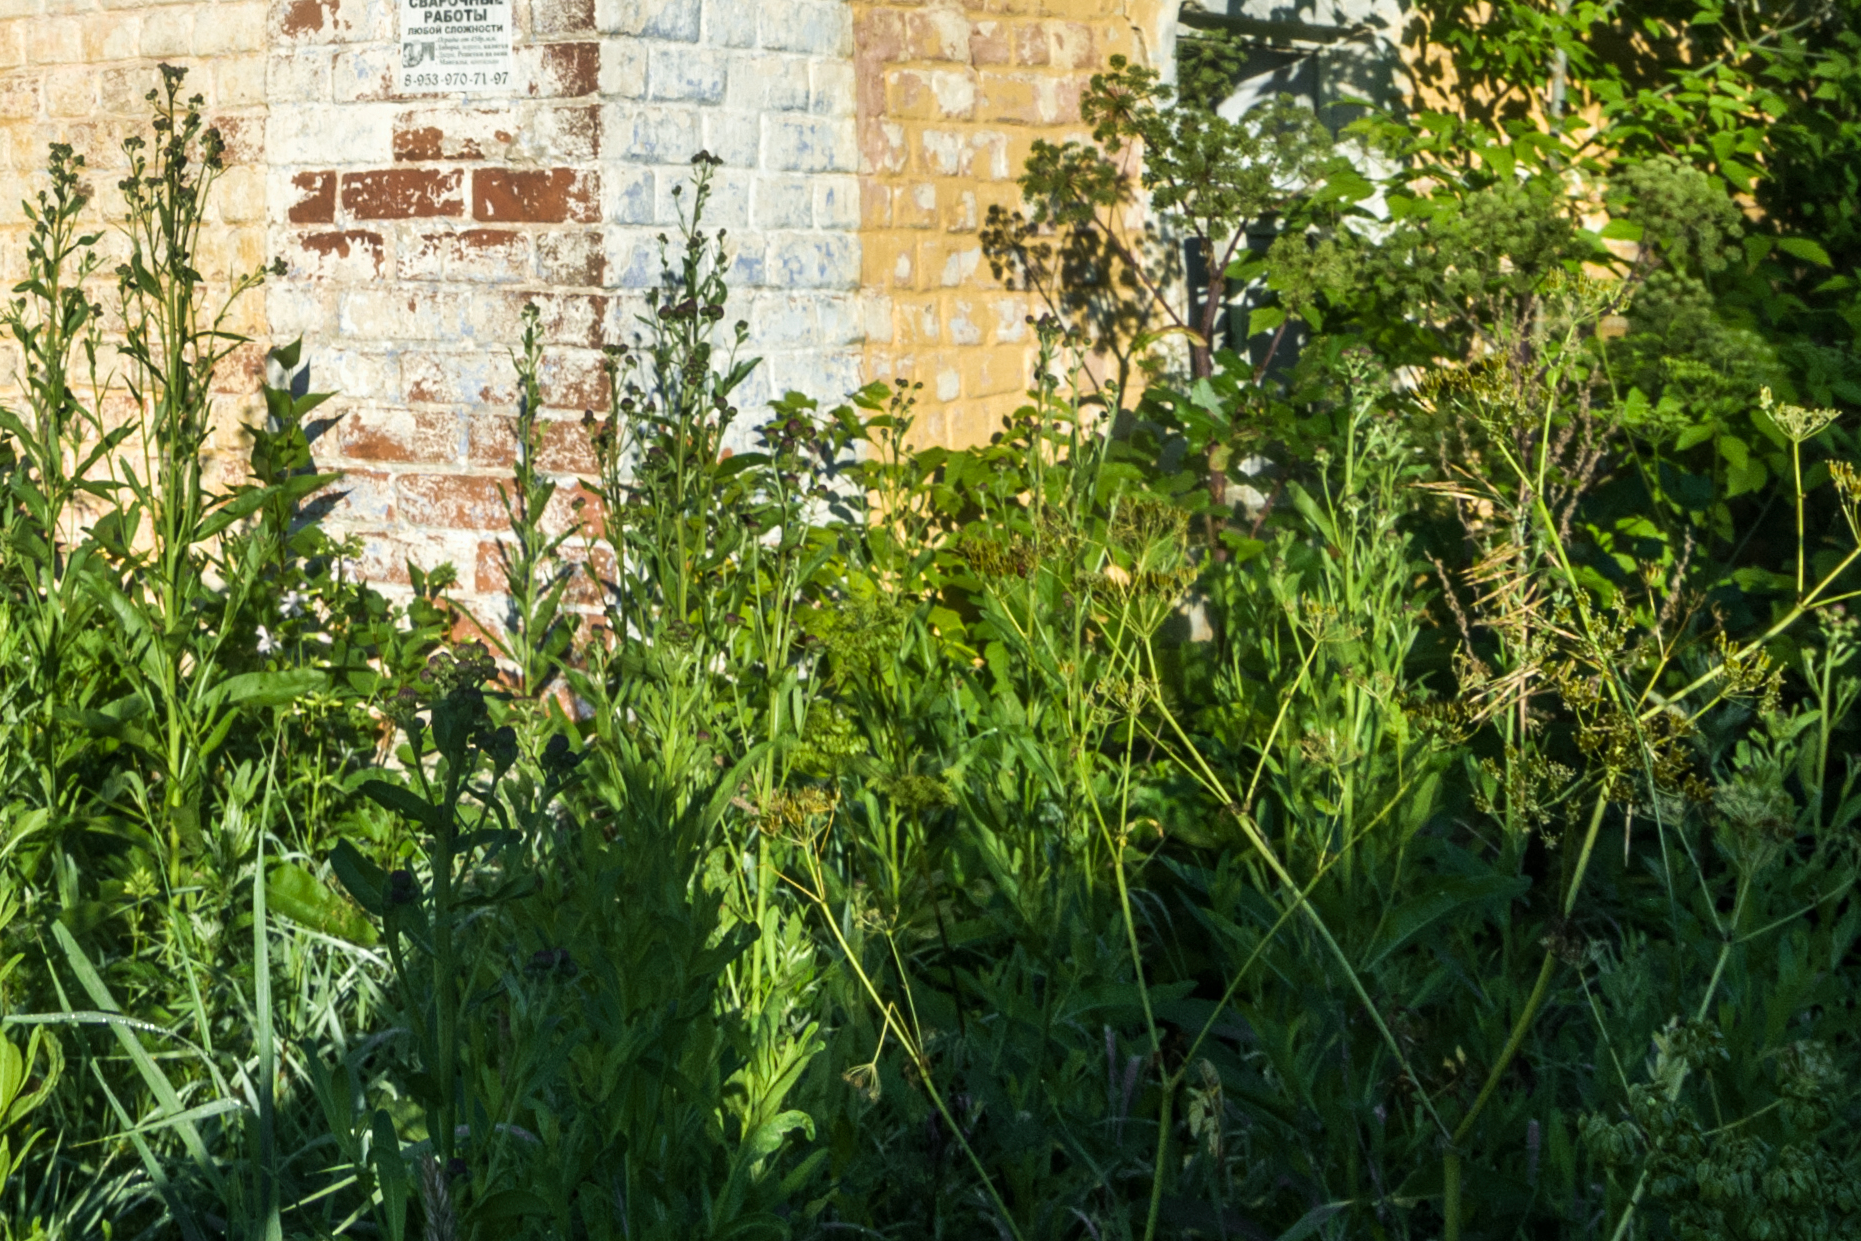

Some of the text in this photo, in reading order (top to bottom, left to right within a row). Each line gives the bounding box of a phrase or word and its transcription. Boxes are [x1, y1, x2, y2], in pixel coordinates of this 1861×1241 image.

[424, 8, 487, 23] РАБОТЫ
[407, 24, 504, 35] ЛЮБОЙ СЛОЖНОСТИ
[403, 71, 509, 87] 8-953-970-71-97
